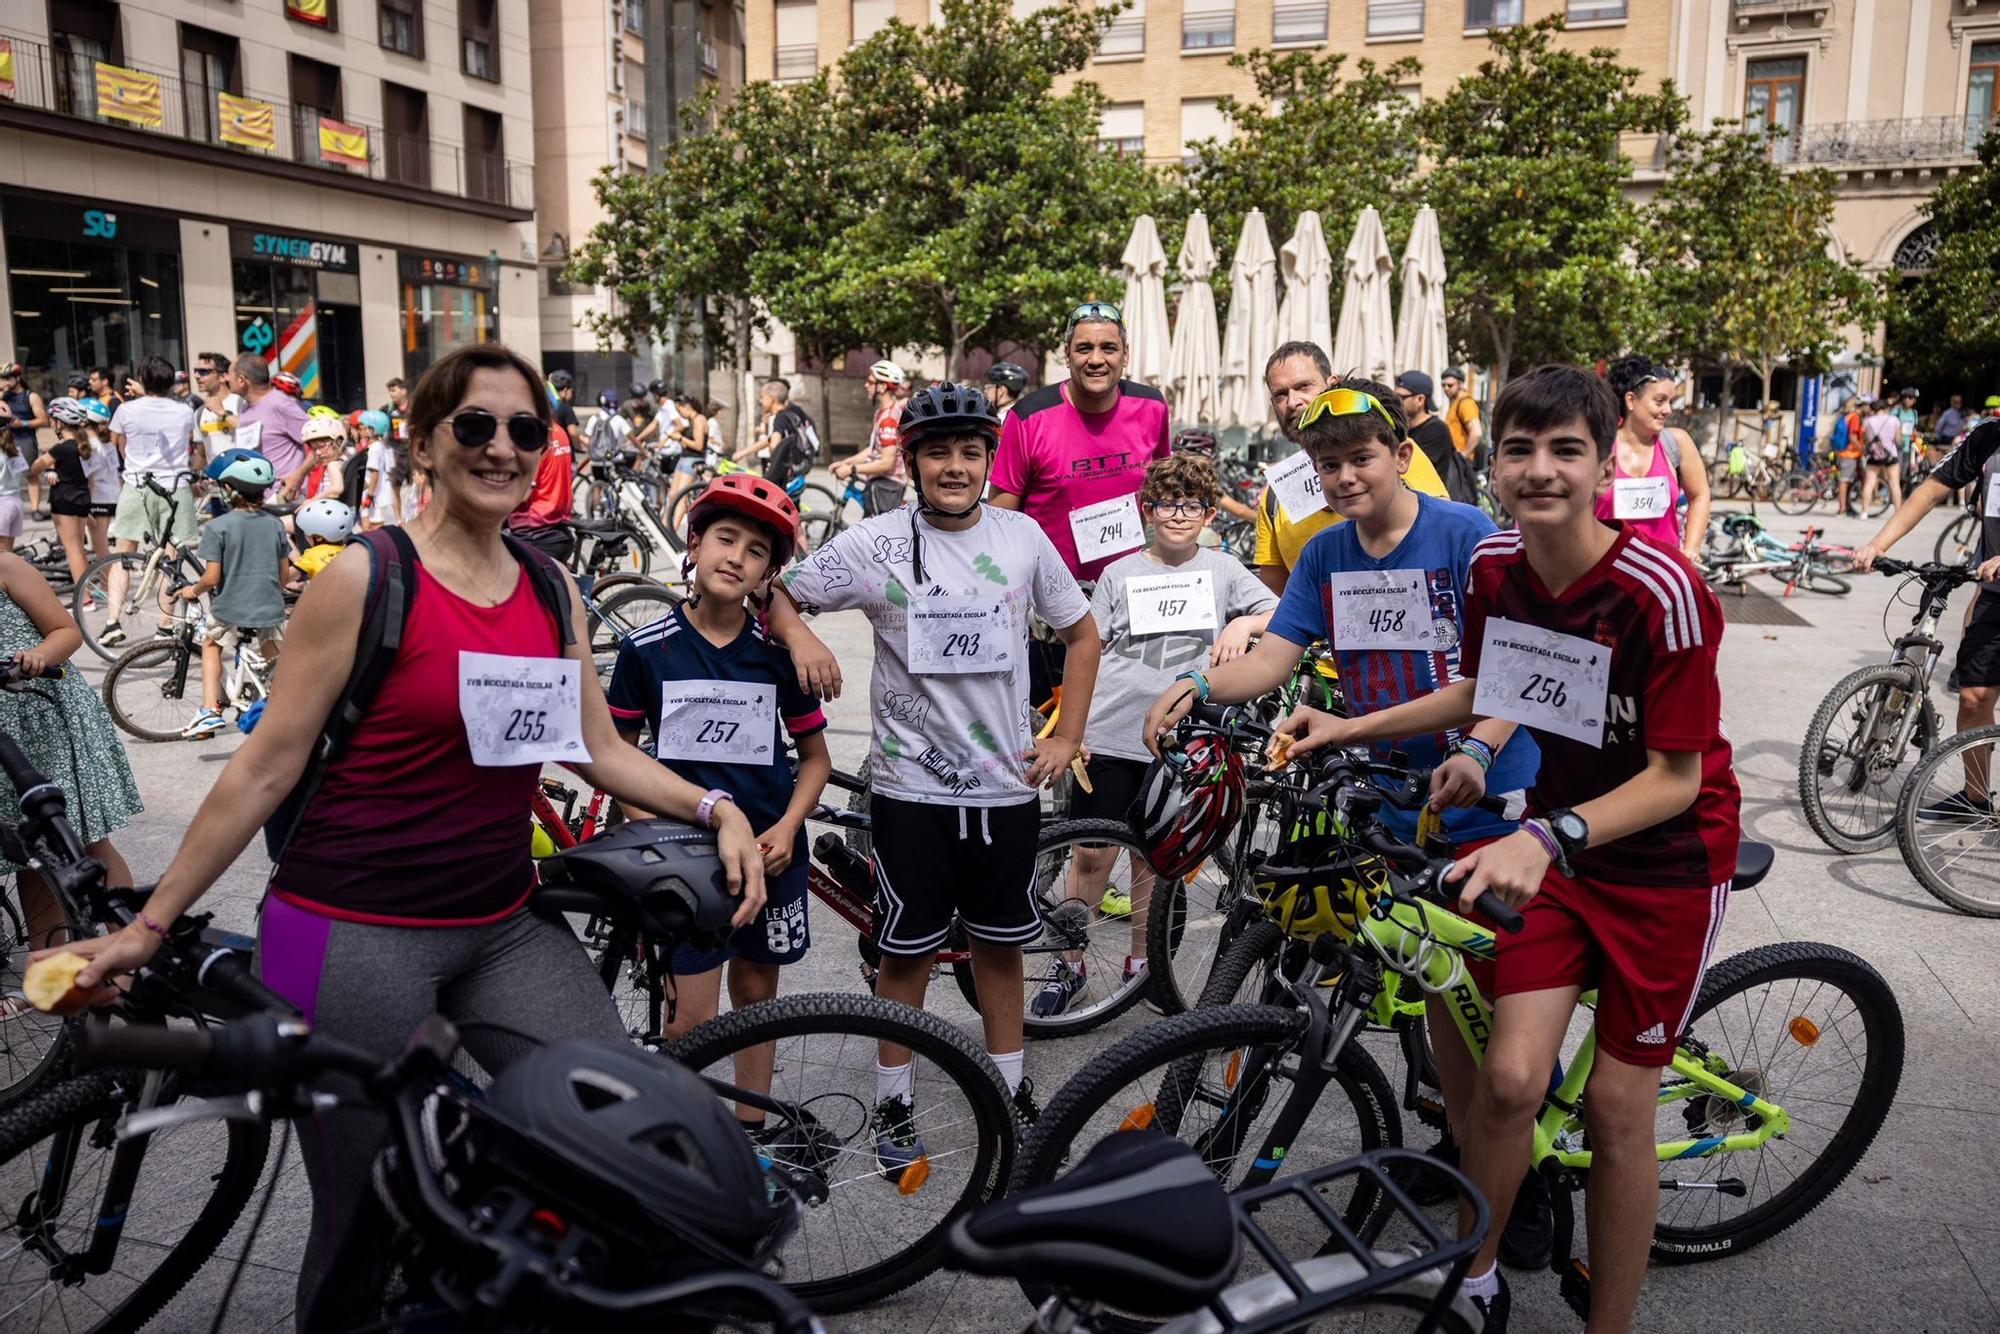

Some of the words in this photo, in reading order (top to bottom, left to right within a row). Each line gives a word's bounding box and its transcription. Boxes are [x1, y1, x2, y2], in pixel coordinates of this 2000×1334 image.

[253, 233, 347, 264] SYNERGYM
[1071, 452, 1132, 472] BTT
[1632, 497, 1653, 510] 354
[1100, 522, 1122, 544] 294
[1158, 600, 1187, 617] 457
[1369, 609, 1406, 633] 458
[943, 633, 980, 657] 293
[1492, 639, 1508, 648] XVIII
[1510, 642, 1551, 657] BICICLETADA
[1553, 652, 1581, 664] ESCOLAR
[483, 679, 525, 689] BICICLETADA
[526, 682, 553, 690] ESCOLAR
[1520, 674, 1567, 708] 256
[684, 697, 720, 706] BICICLETADA
[880, 690, 931, 731] SEA
[504, 709, 547, 741] 255
[696, 720, 740, 743] 257
[765, 897, 804, 921] LEAGUE
[766, 911, 806, 953] 83
[1636, 1034, 1667, 1045] adidas
[1686, 1239, 1732, 1253] BTWIN
